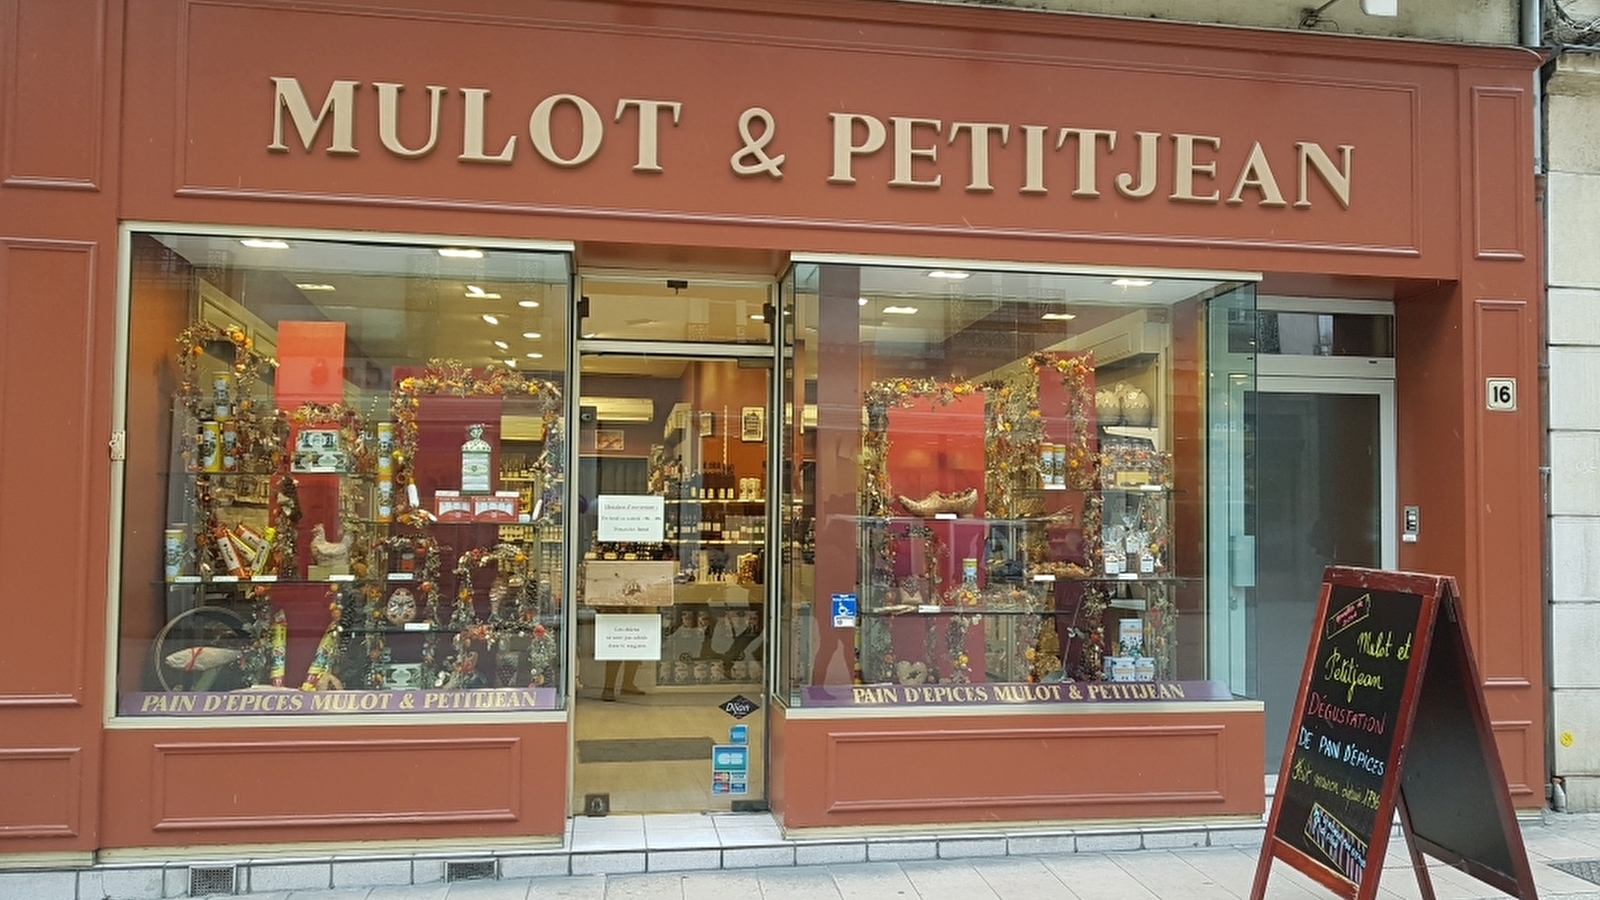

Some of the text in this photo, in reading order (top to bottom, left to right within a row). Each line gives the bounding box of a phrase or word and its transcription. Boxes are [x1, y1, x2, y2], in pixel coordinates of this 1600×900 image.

[267, 76, 1355, 209] MULOT & PETITJEAN
[1493, 386, 1511, 403] 16
[1397, 632, 1412, 660] et
[1324, 646, 1384, 703] Petitjean
[141, 694, 197, 713] PAIN
[310, 692, 392, 711] MULOT
[400, 693, 415, 710] &
[424, 690, 537, 710] PETITJEAN
[853, 687, 898, 703] PAIN
[991, 685, 1060, 702] MULOT
[1069, 685, 1083, 700] &
[1089, 683, 1185, 700] PETITJEAN
[1298, 725, 1314, 750] DE
